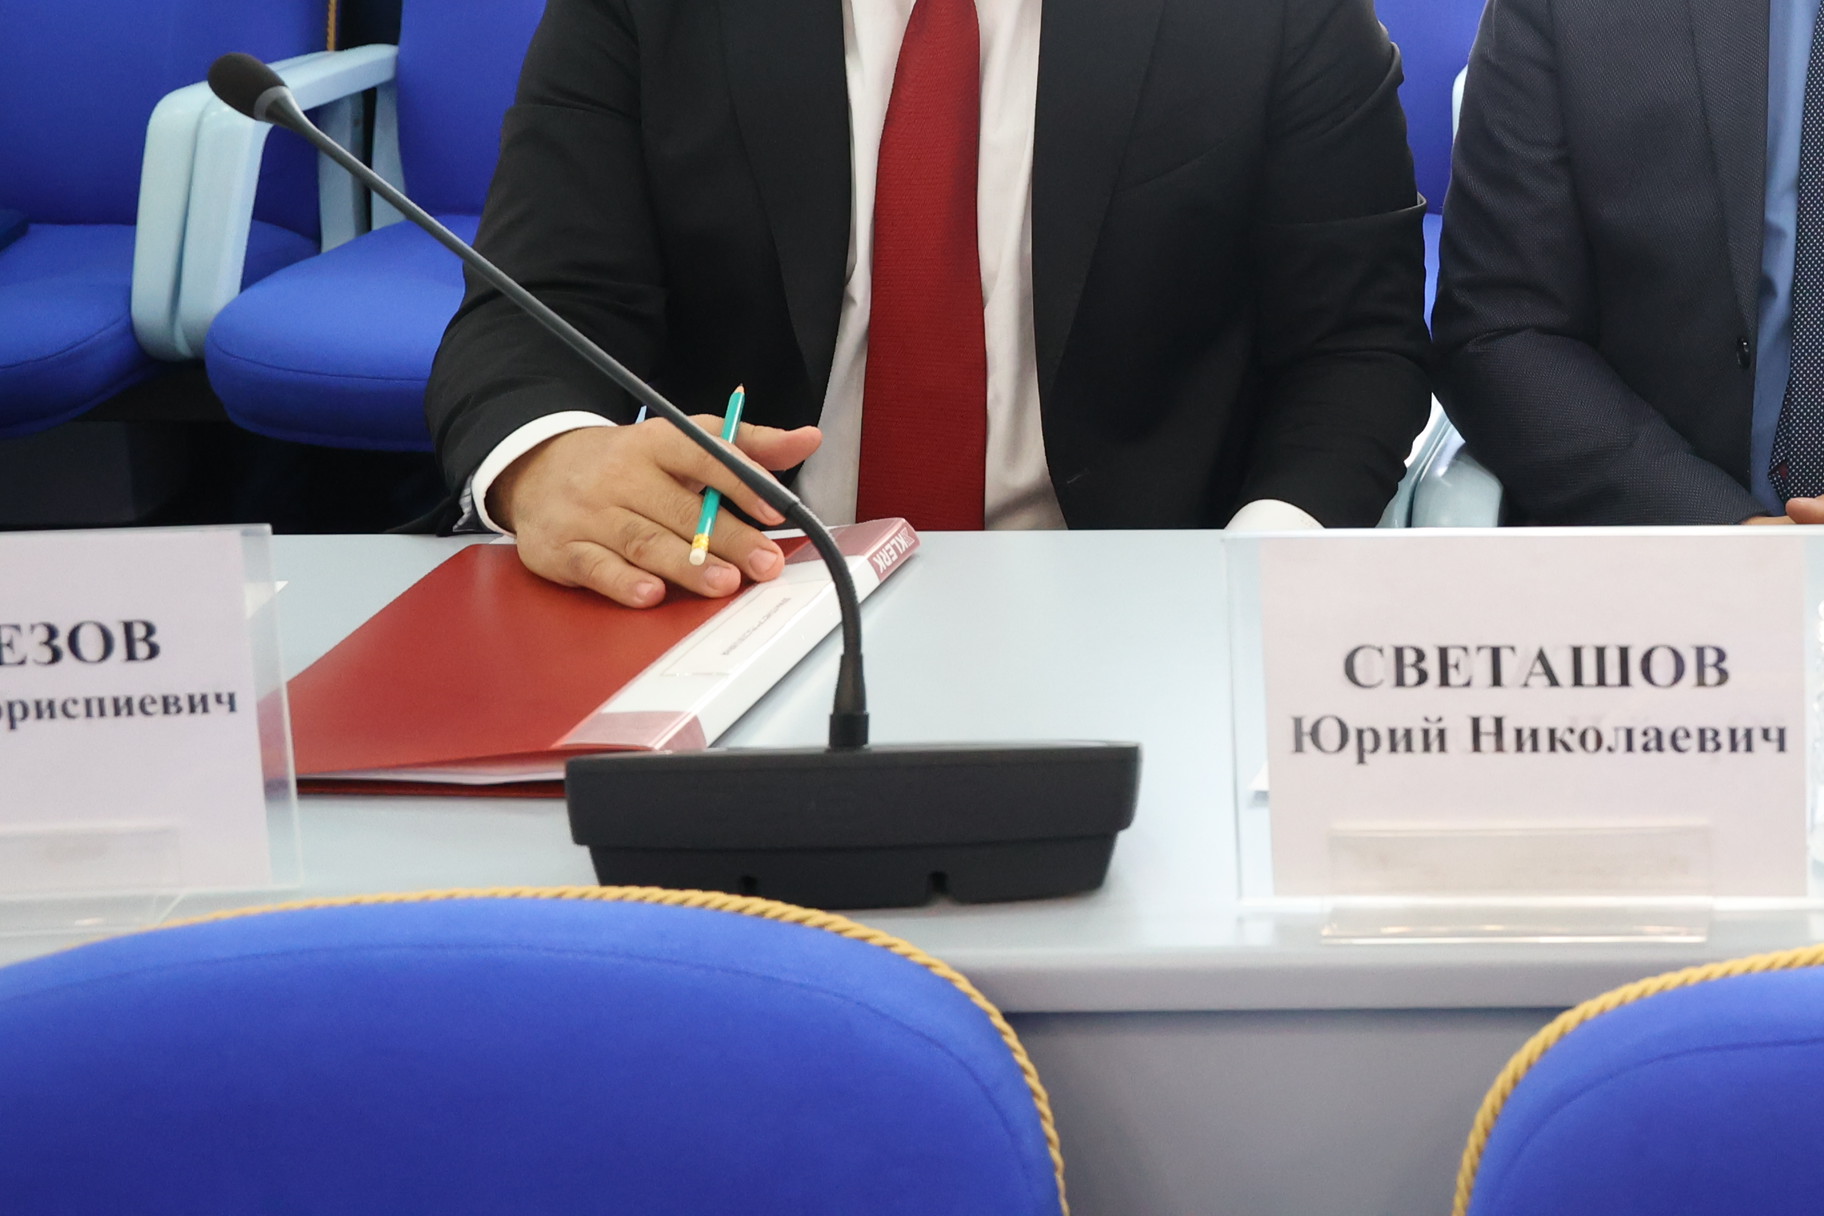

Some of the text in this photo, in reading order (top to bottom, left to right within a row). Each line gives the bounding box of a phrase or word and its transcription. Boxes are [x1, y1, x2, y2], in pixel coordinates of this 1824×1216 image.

[872, 530, 911, 574] KLERK
[1343, 644, 1731, 690] СВЕТАШОВ
[0, 691, 238, 731] риспиевич
[1290, 714, 1788, 765] Юрий Николаевич
